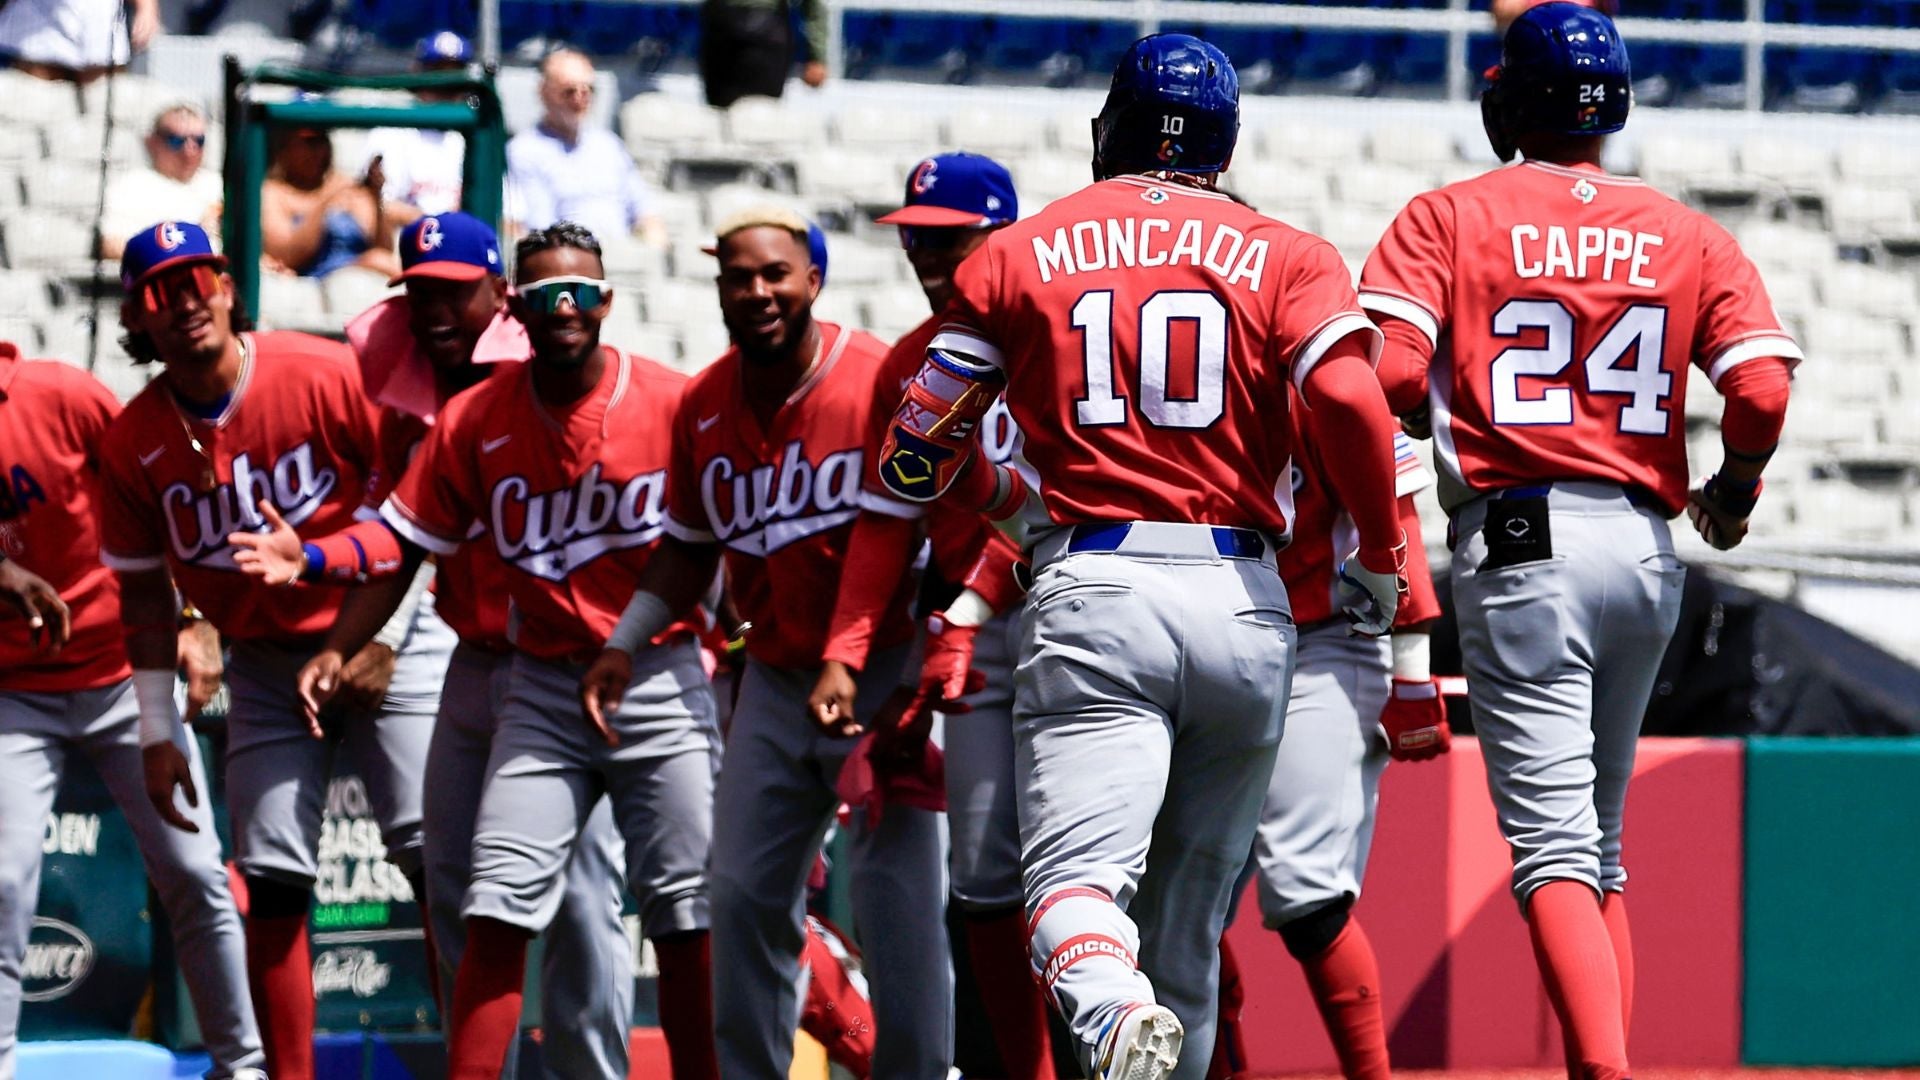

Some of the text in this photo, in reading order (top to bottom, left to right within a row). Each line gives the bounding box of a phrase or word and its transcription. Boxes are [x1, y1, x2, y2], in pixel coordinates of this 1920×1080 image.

[1160, 114, 1185, 136] 10
[1579, 83, 1606, 103] 24
[1031, 217, 1270, 293] MONCADA
[1510, 223, 1664, 289] CAPPE
[1069, 288, 1231, 430] 10
[1489, 296, 1675, 438] 24
[161, 440, 325, 562] Cuba
[490, 462, 668, 560] Cuba
[700, 439, 864, 540] Cuba
